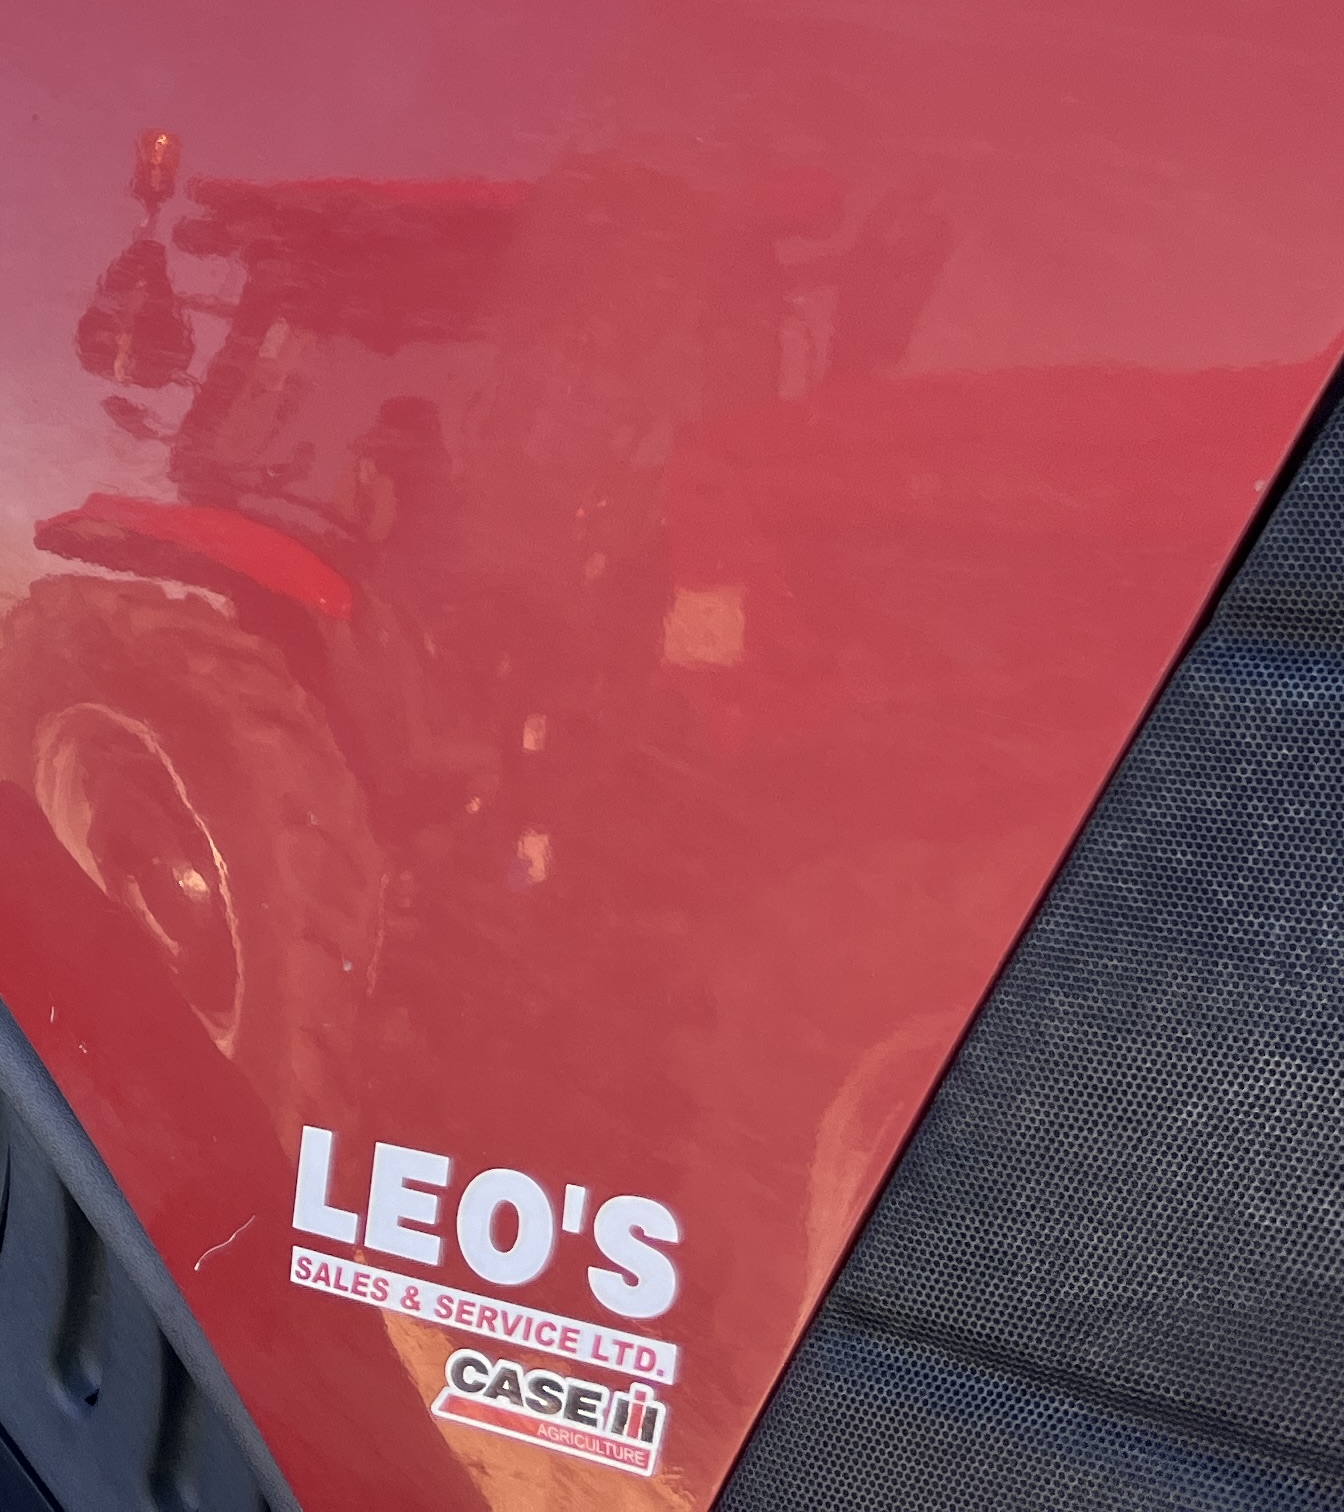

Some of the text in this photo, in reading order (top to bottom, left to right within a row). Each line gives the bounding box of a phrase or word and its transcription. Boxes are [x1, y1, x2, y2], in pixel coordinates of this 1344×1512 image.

[292, 1125, 679, 1318] LEO'S
[294, 1256, 665, 1377] SALES & SERVICE LTD.
[449, 1356, 604, 1427] CASE
[536, 1423, 645, 1465] AGRICULTURE
